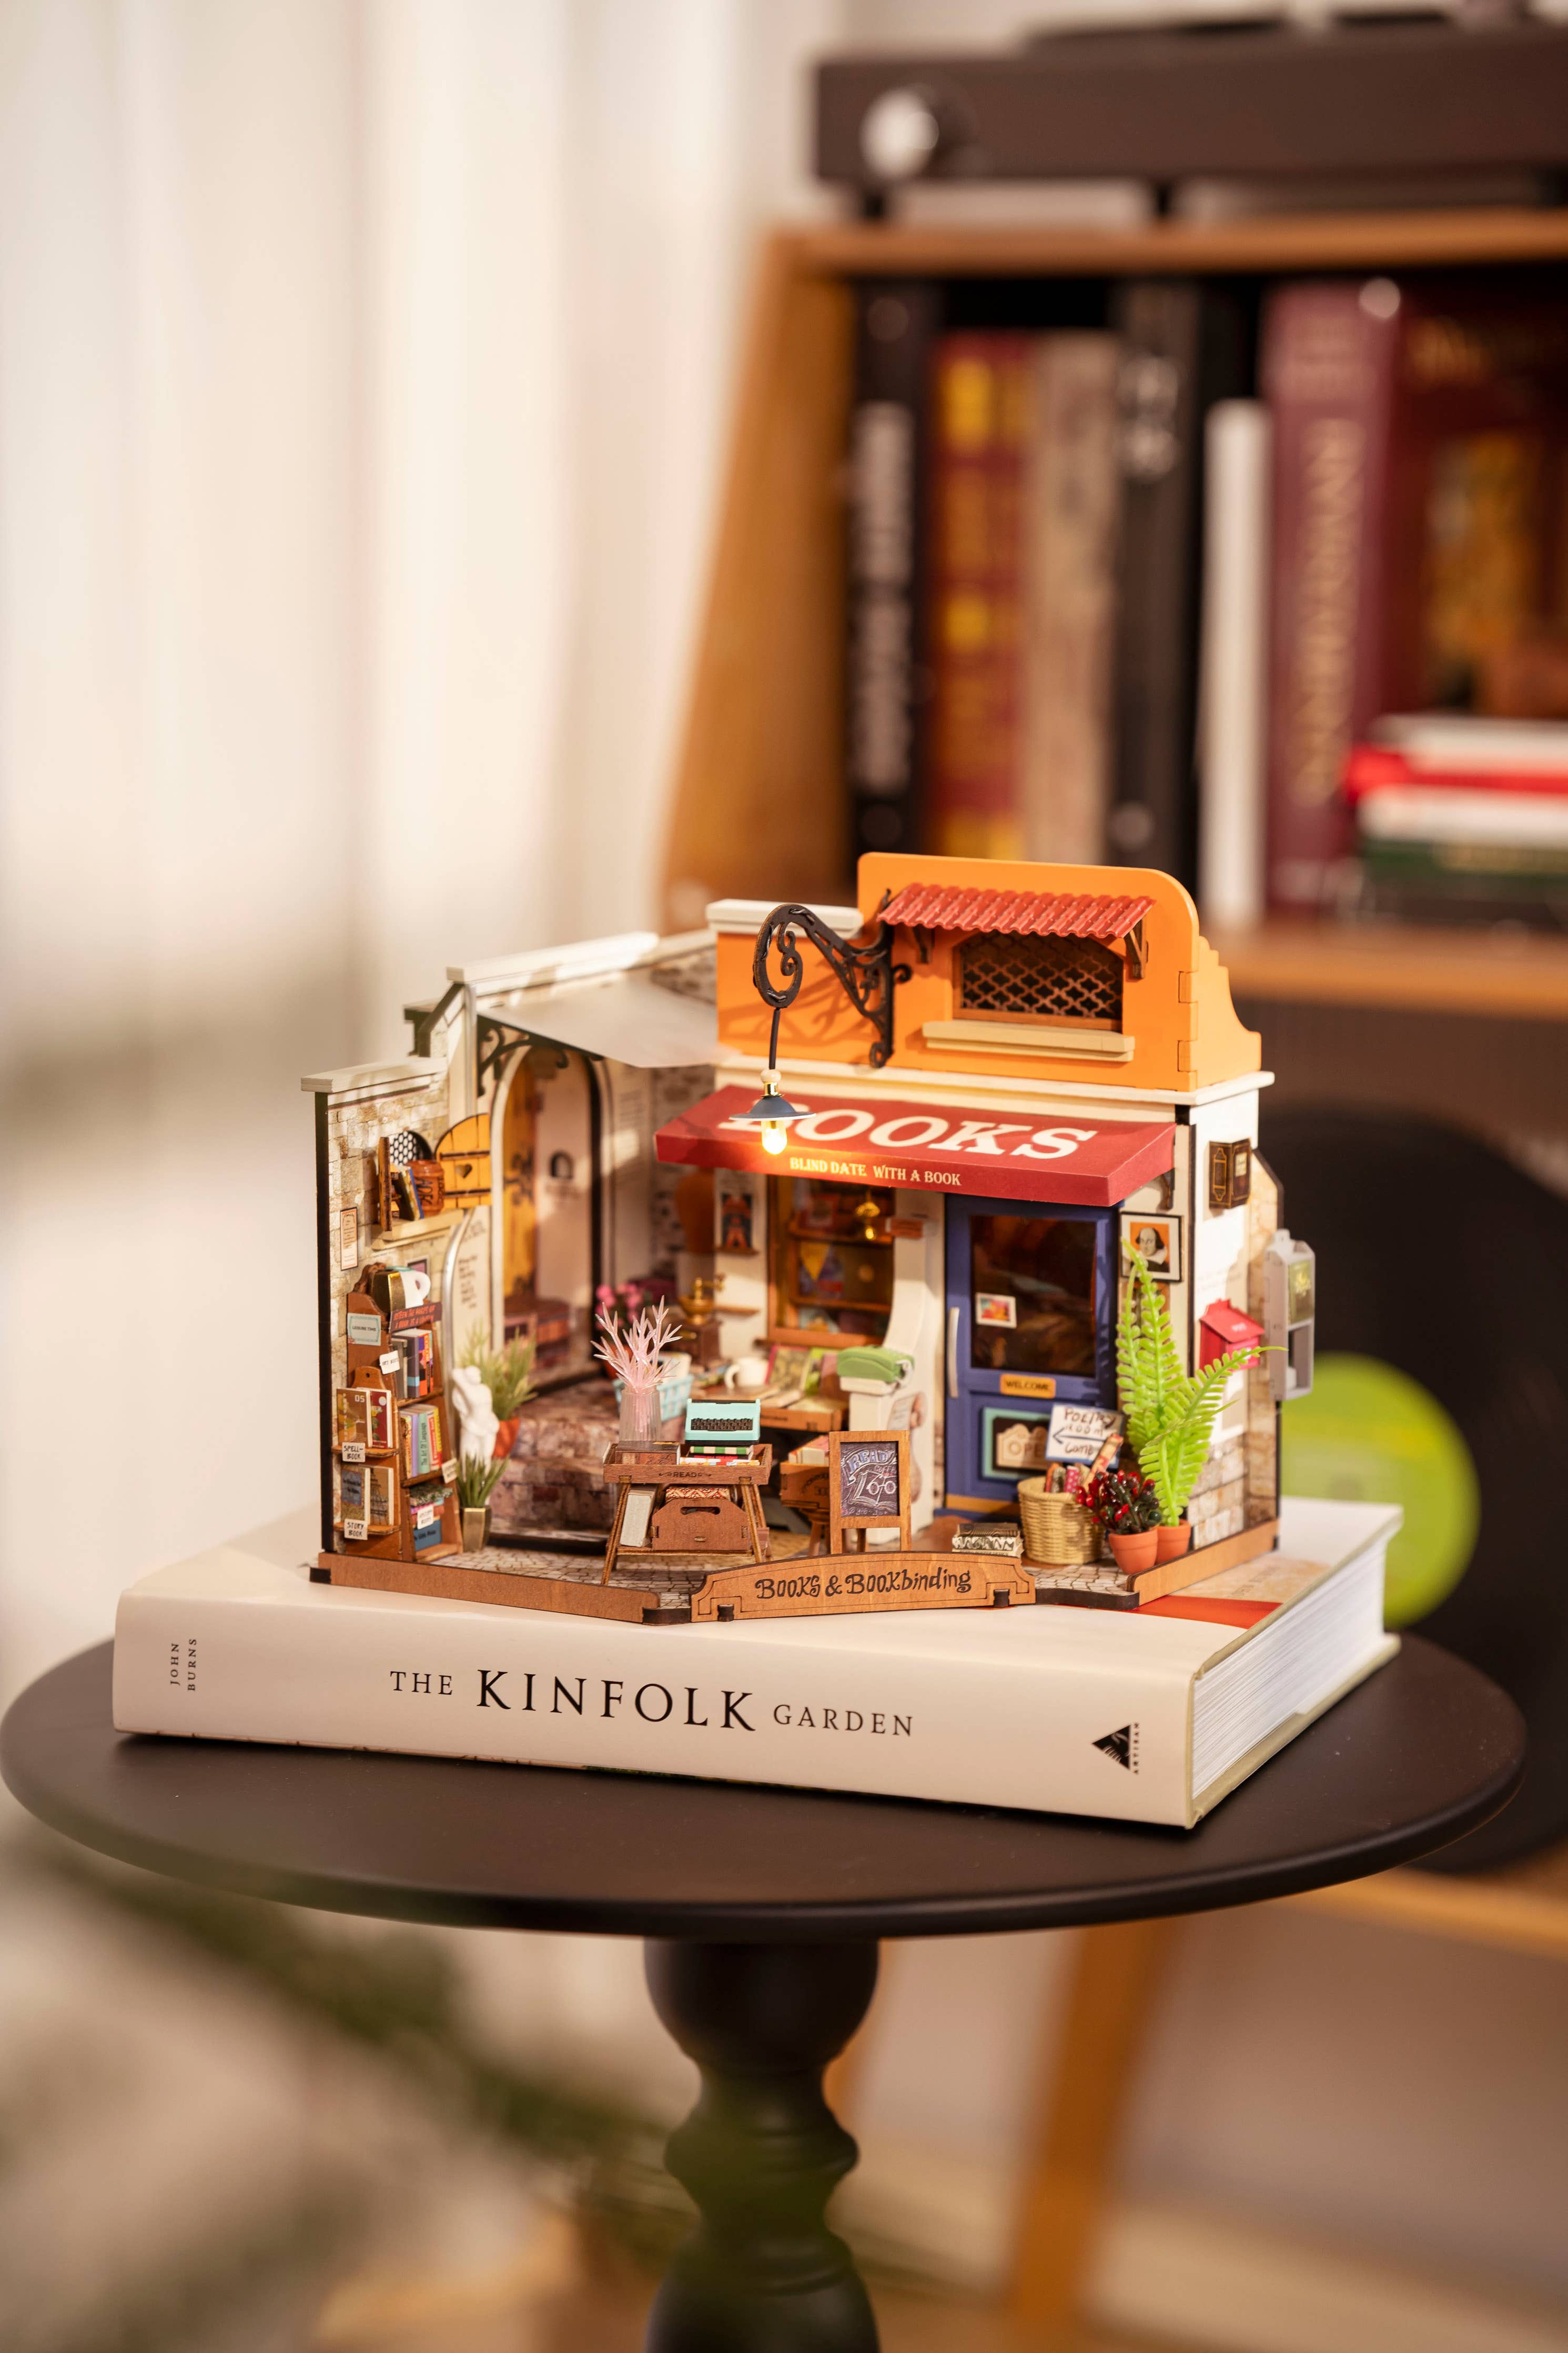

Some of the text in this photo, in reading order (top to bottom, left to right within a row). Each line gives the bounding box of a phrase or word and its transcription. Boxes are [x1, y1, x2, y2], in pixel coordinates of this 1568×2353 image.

[790, 1157, 962, 1186] BLIND DATE WITH A BOOK
[1006, 1380, 1049, 1390] WELCOME
[846, 1449, 889, 1474] READ
[825, 1575, 843, 1597] &
[169, 1643, 180, 1686] JOHN
[187, 1638, 197, 1691] BURNS
[390, 1669, 913, 1736] THE KINFOLK GARDEN
